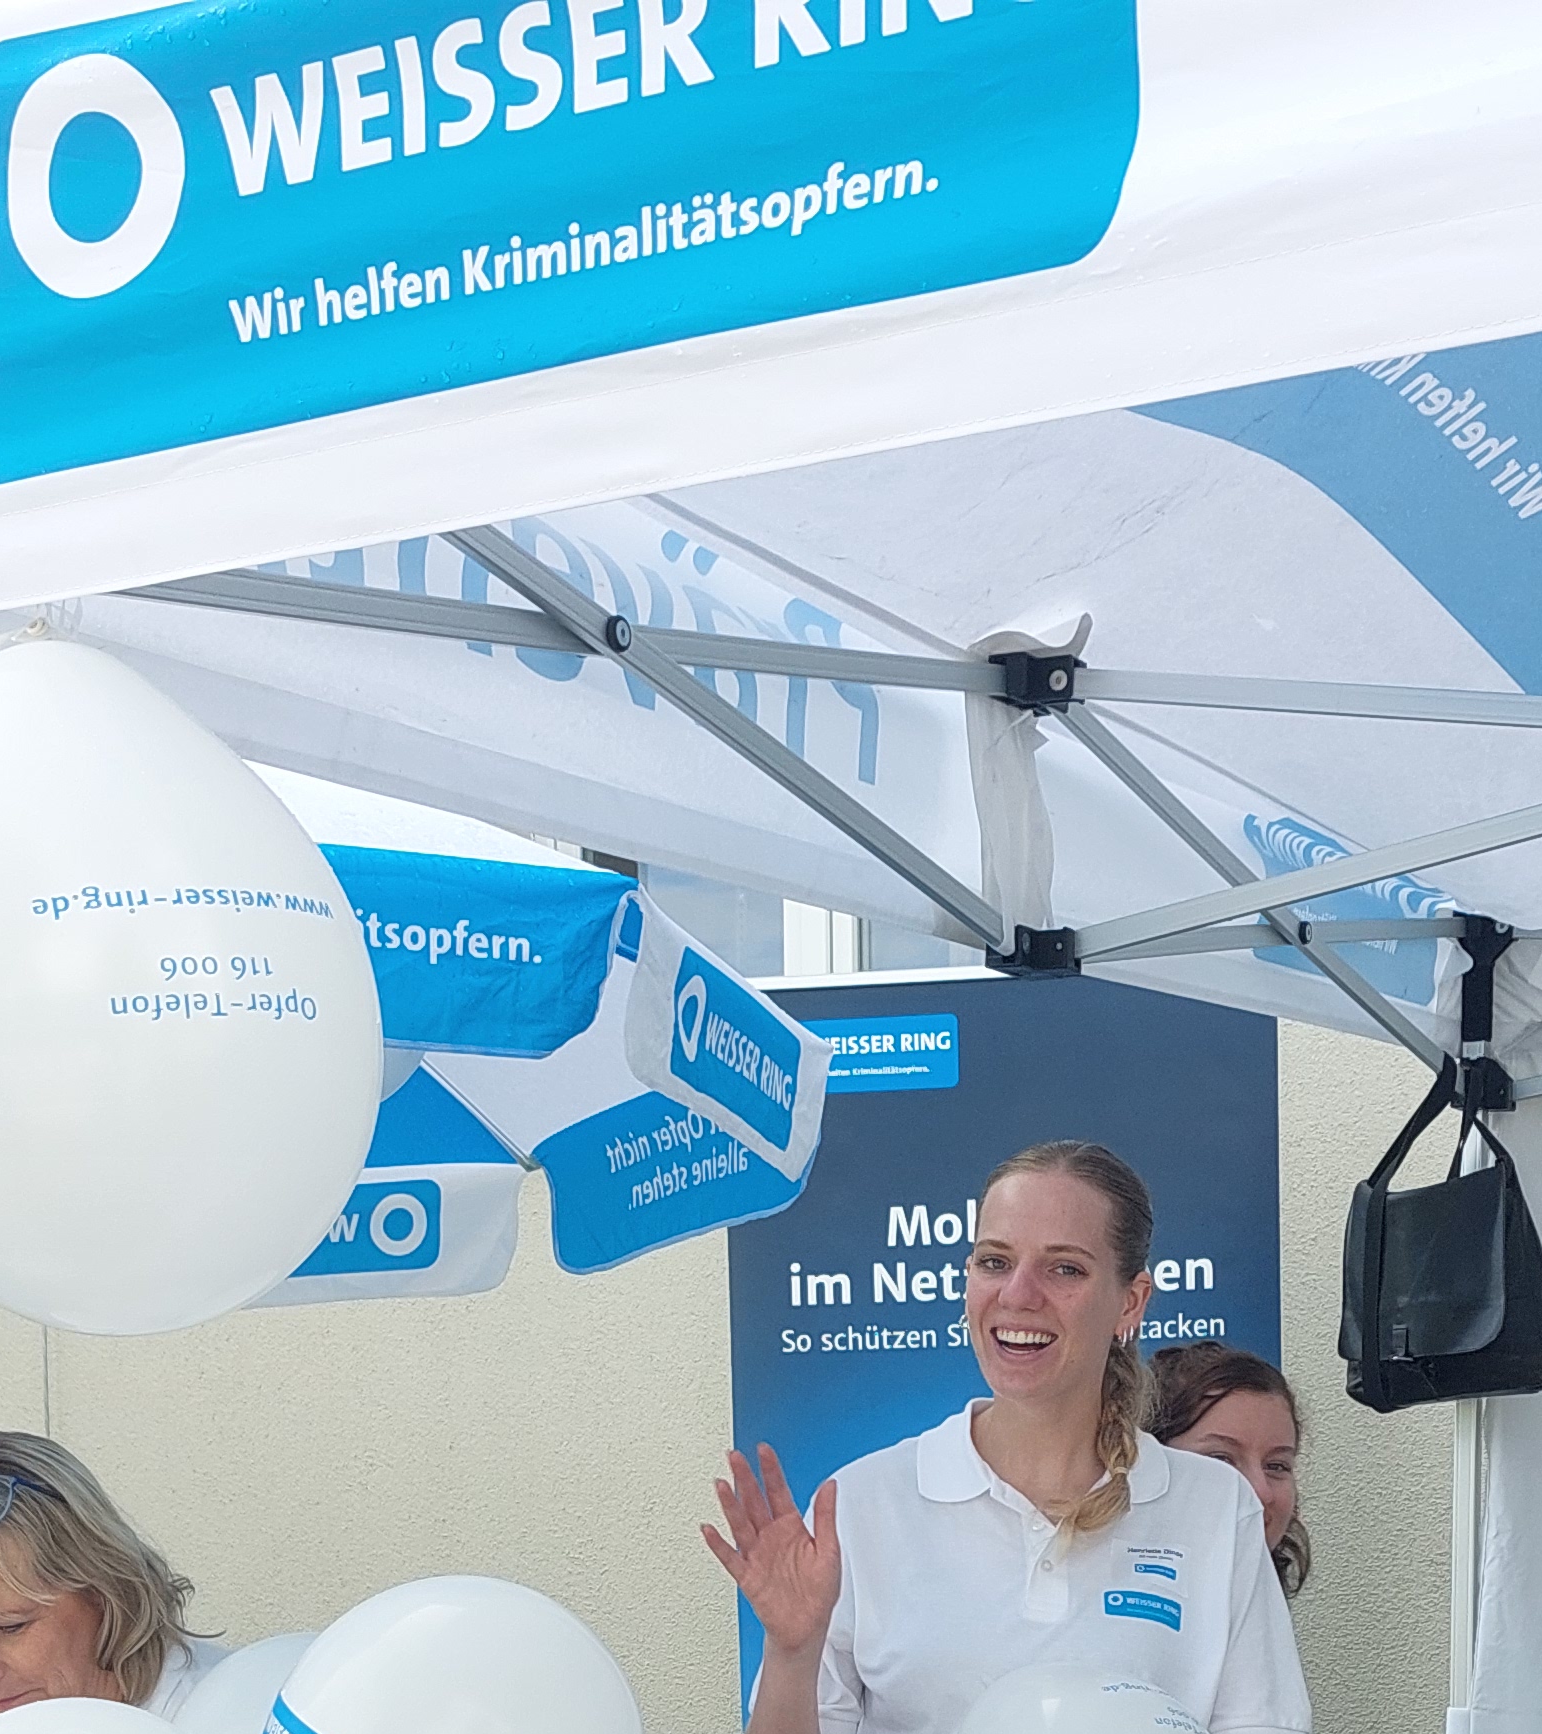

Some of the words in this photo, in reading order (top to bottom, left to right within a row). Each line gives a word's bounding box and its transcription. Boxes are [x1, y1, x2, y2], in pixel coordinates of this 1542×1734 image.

[209, 0, 716, 197] WEISSER
[228, 287, 306, 343] Wir
[314, 260, 451, 328] helfen
[462, 158, 941, 296] Kriminalitätsopfern.
[32, 886, 335, 920] www.weisser-ring.de
[160, 956, 219, 981] 006
[230, 956, 274, 980] 116
[110, 990, 318, 1021] Opfer-Telefon
[901, 1031, 951, 1052] RING
[705, 1010, 761, 1089] WEISSER
[760, 1054, 793, 1112] RING
[790, 1262, 852, 1306] im
[873, 1260, 971, 1302] Net
[782, 1328, 812, 1353] So
[821, 1326, 937, 1351] schützen
